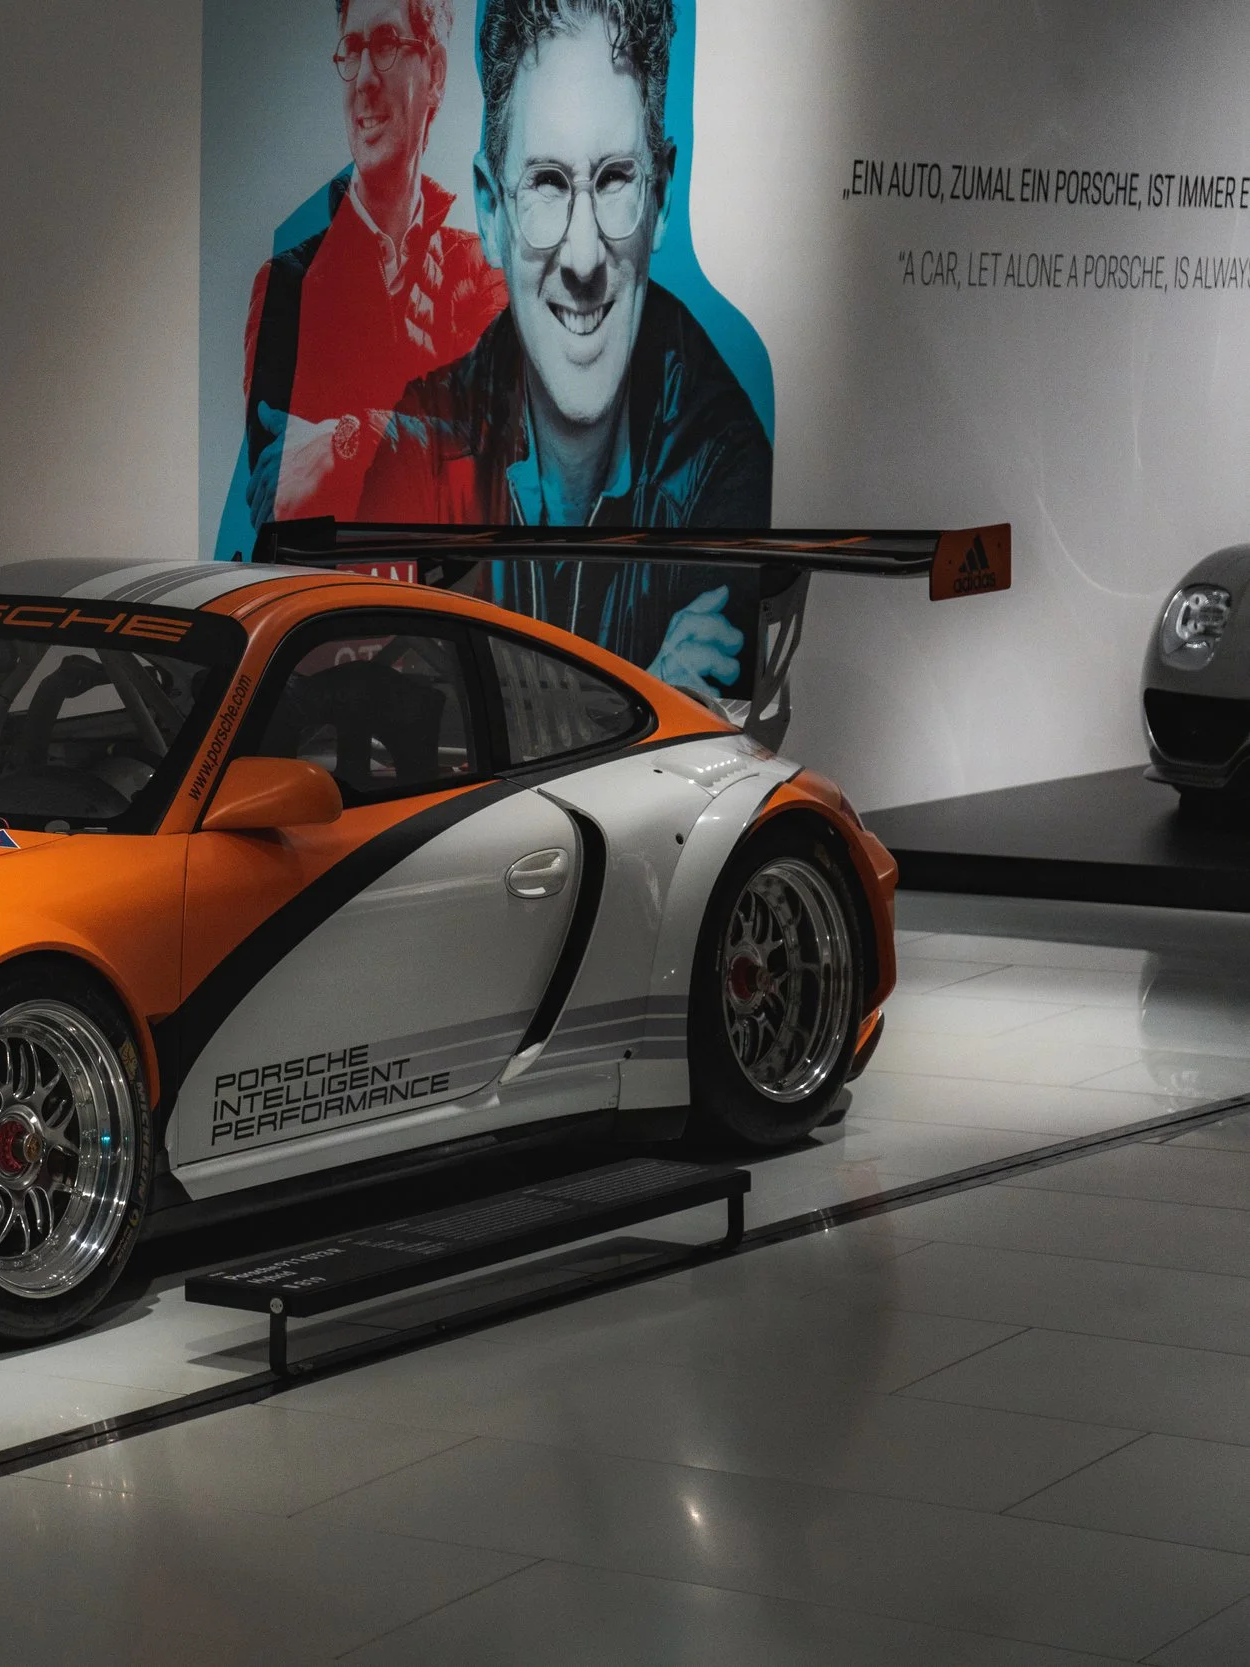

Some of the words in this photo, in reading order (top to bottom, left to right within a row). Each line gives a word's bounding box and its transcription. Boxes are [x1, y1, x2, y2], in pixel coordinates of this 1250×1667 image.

[887, 161, 945, 204] AUTO,
[950, 164, 1015, 202] ZUMAL
[1020, 167, 1050, 203] EIN
[1055, 169, 1142, 211] PORSCHE,
[1147, 173, 1176, 208] IST
[1178, 174, 1236, 209] IMMER
[920, 250, 961, 291] CAR,
[968, 251, 1002, 287] LET
[1004, 252, 1064, 289] ALONE
[1067, 254, 1079, 288] A
[1083, 254, 1168, 293] PORSCHE,
[1174, 256, 1190, 289] IS
[954, 572, 996, 593] adidas
[188, 673, 252, 802] www.porsche.com
[213, 1058, 410, 1122] INTELLIGENT
[214, 1044, 369, 1098] PORSCHE
[211, 1072, 450, 1146] PERFORMANCE
